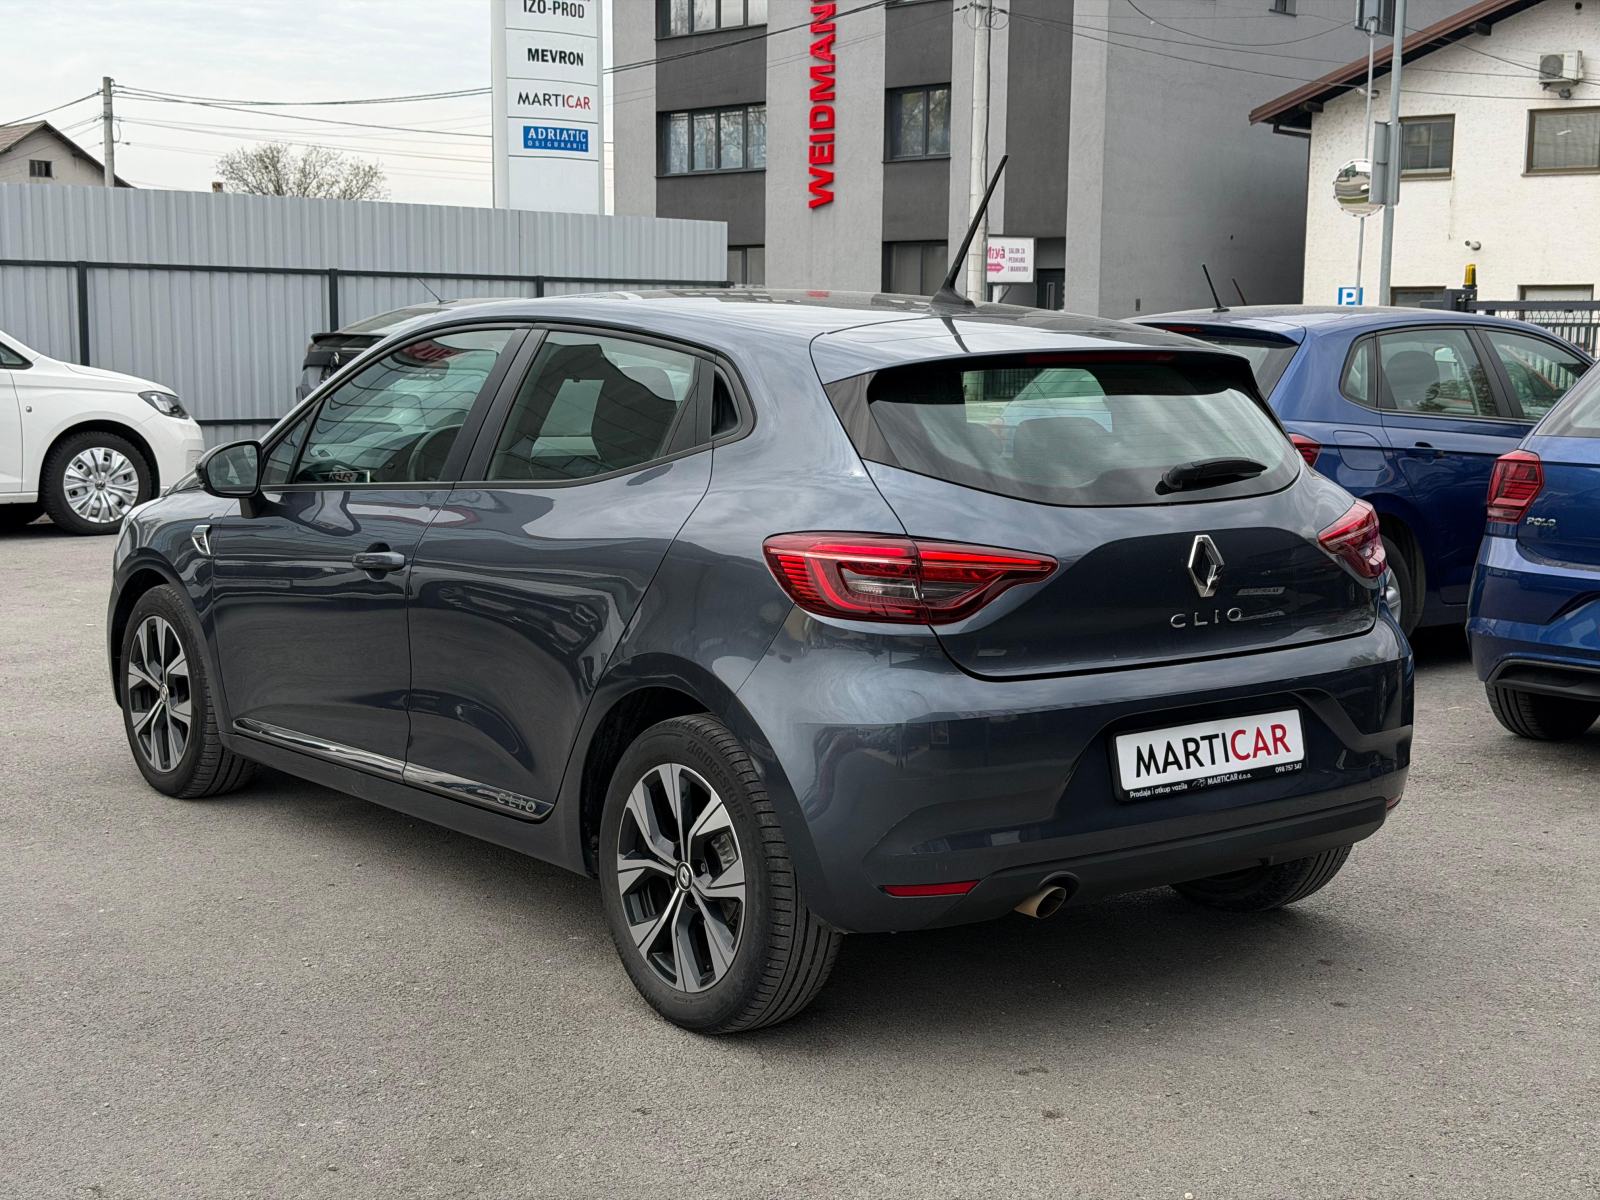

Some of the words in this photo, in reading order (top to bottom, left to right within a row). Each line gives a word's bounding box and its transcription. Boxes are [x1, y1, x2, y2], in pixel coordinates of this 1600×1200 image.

[523, 0, 585, 18] IZO-PROD
[527, 48, 584, 67] MEVRON
[517, 91, 591, 110] MARTICAR
[808, 0, 836, 209] WEIDMAN
[528, 128, 586, 142] ADRIATIC
[1342, 288, 1359, 305] P
[1526, 516, 1556, 526] POLO
[1170, 607, 1242, 629] CLIO
[1135, 723, 1292, 778] MARTICAR
[1207, 772, 1238, 785] MARTICAR
[1129, 788, 1151, 799] Prodaja
[1154, 785, 1171, 795] otkup
[1171, 782, 1188, 791] vozila
